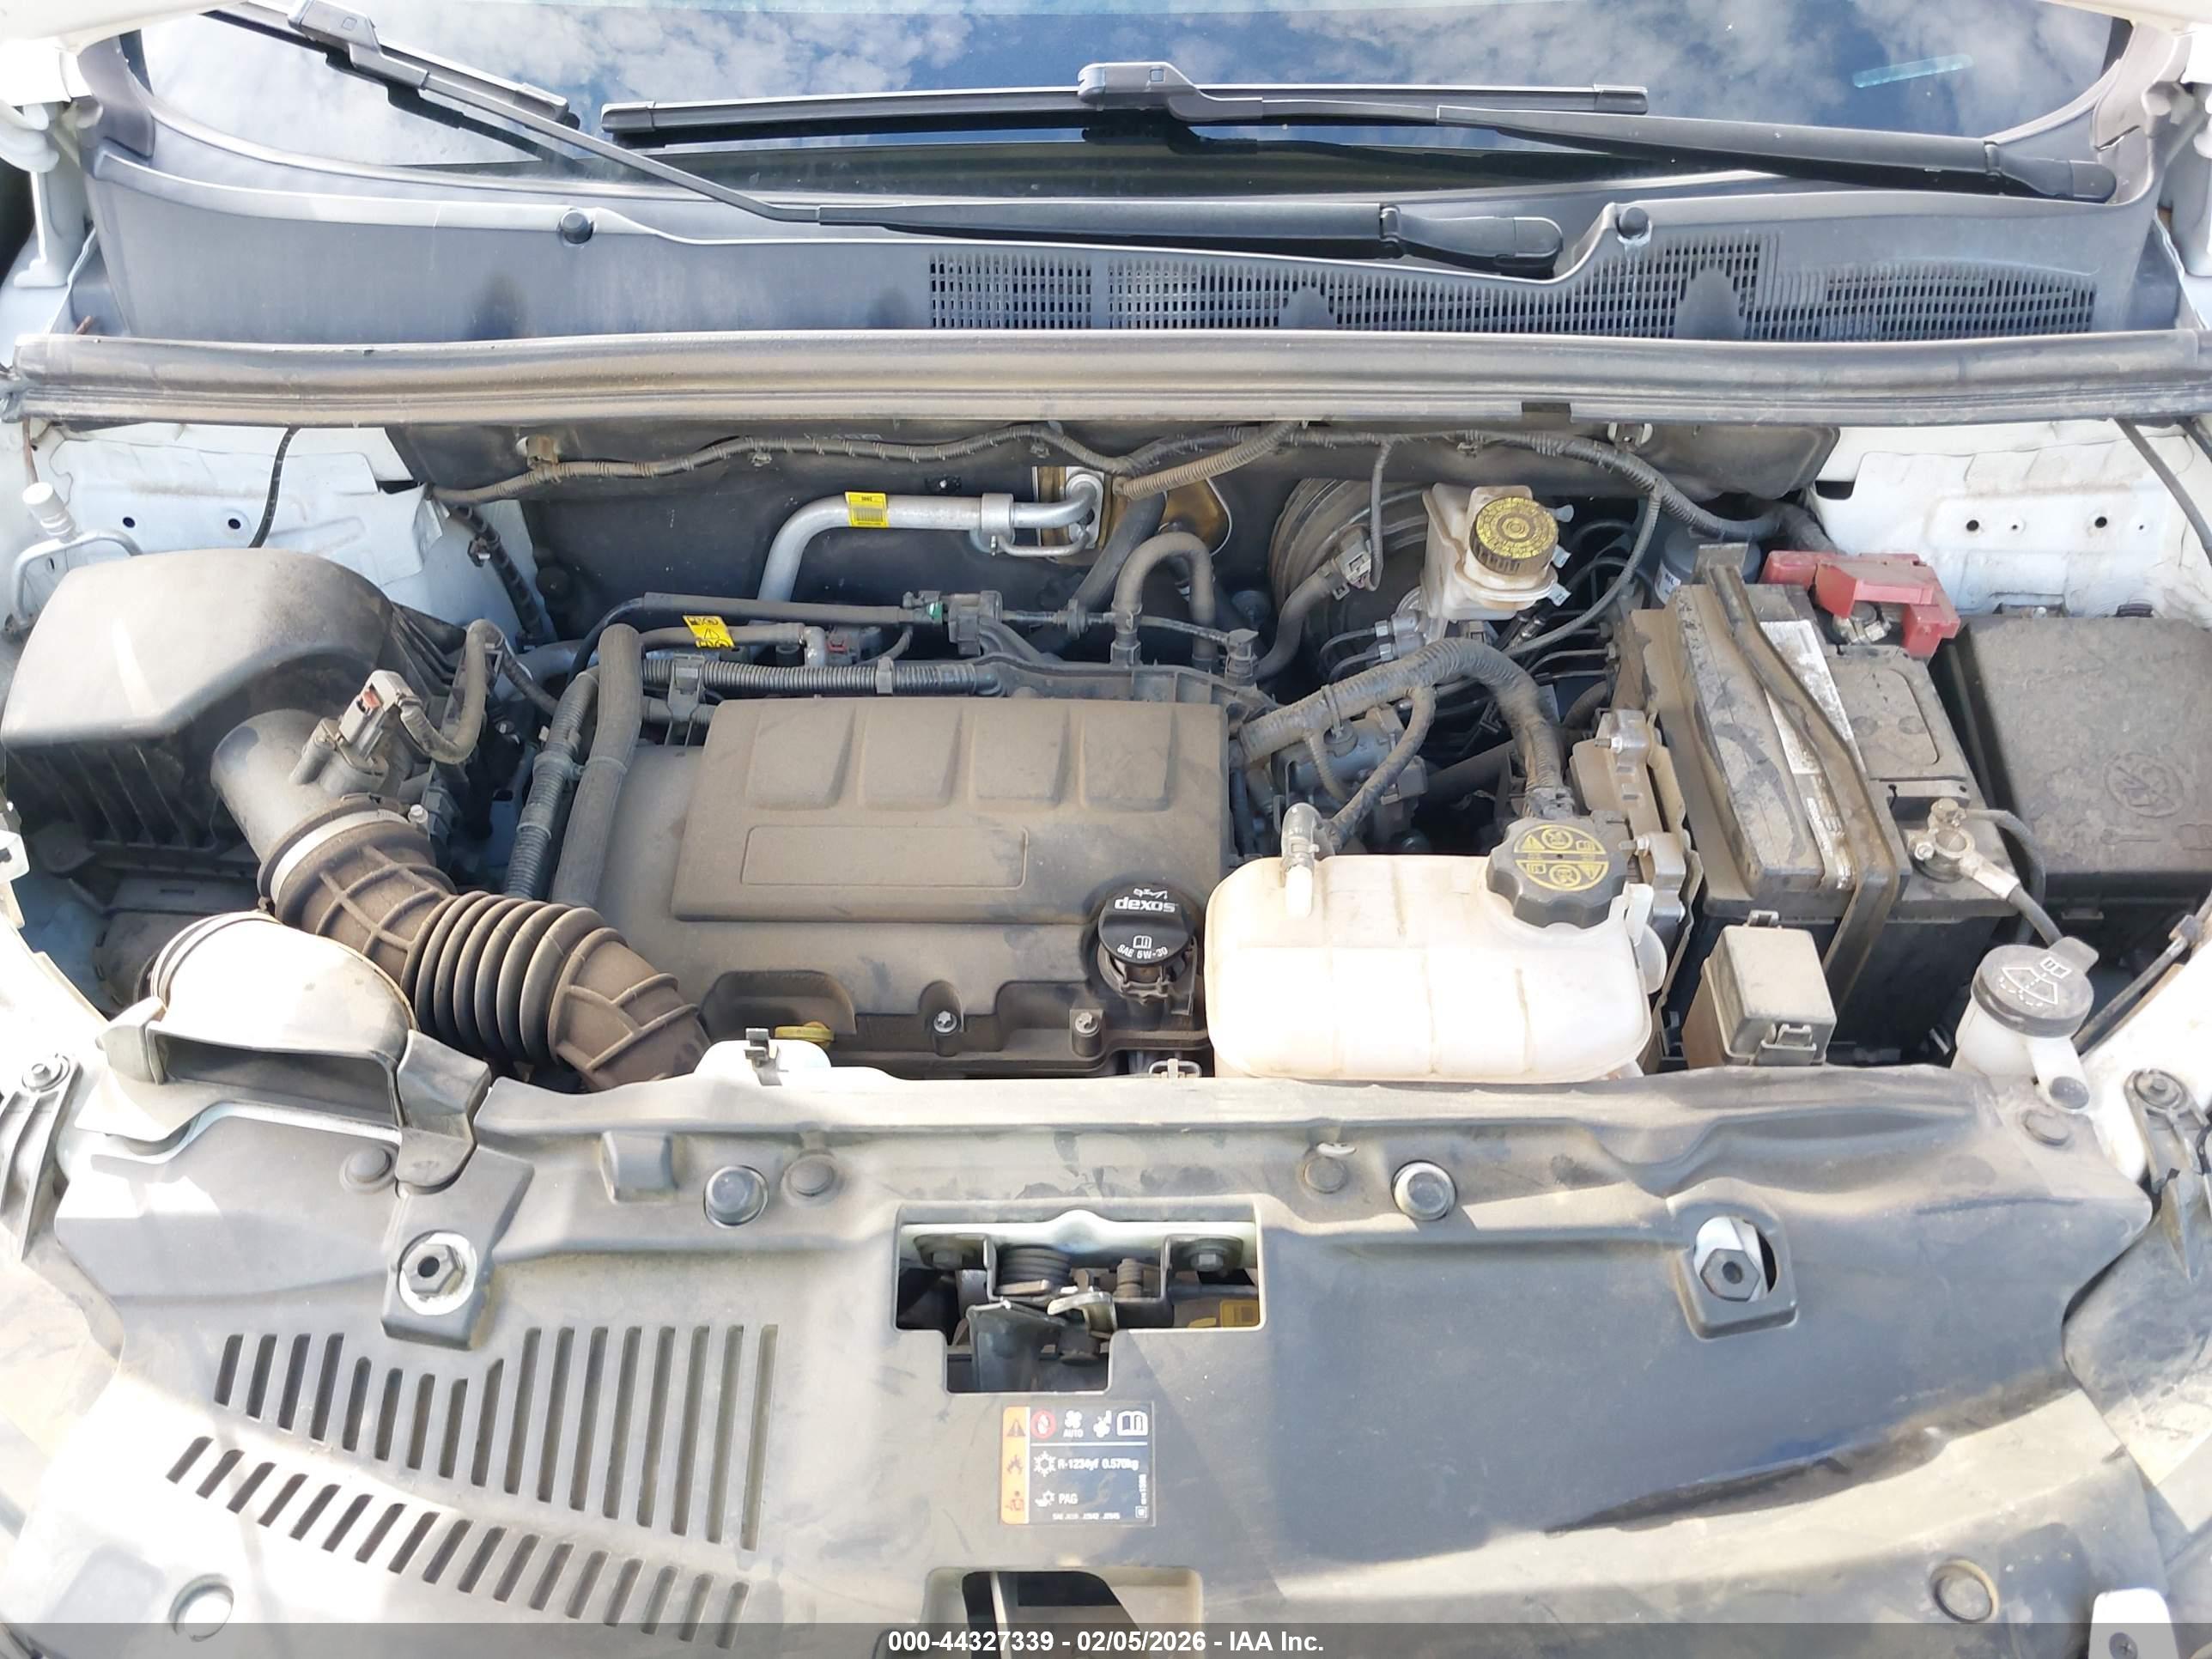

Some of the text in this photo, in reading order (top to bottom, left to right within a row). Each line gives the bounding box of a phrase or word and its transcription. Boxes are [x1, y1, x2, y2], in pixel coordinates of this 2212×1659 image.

[1115, 896, 1176, 913] dexos
[1117, 944, 1168, 960] SAE 5W-30
[1063, 1429, 1084, 1438] AUTO
[1058, 1492, 1079, 1504] PAG
